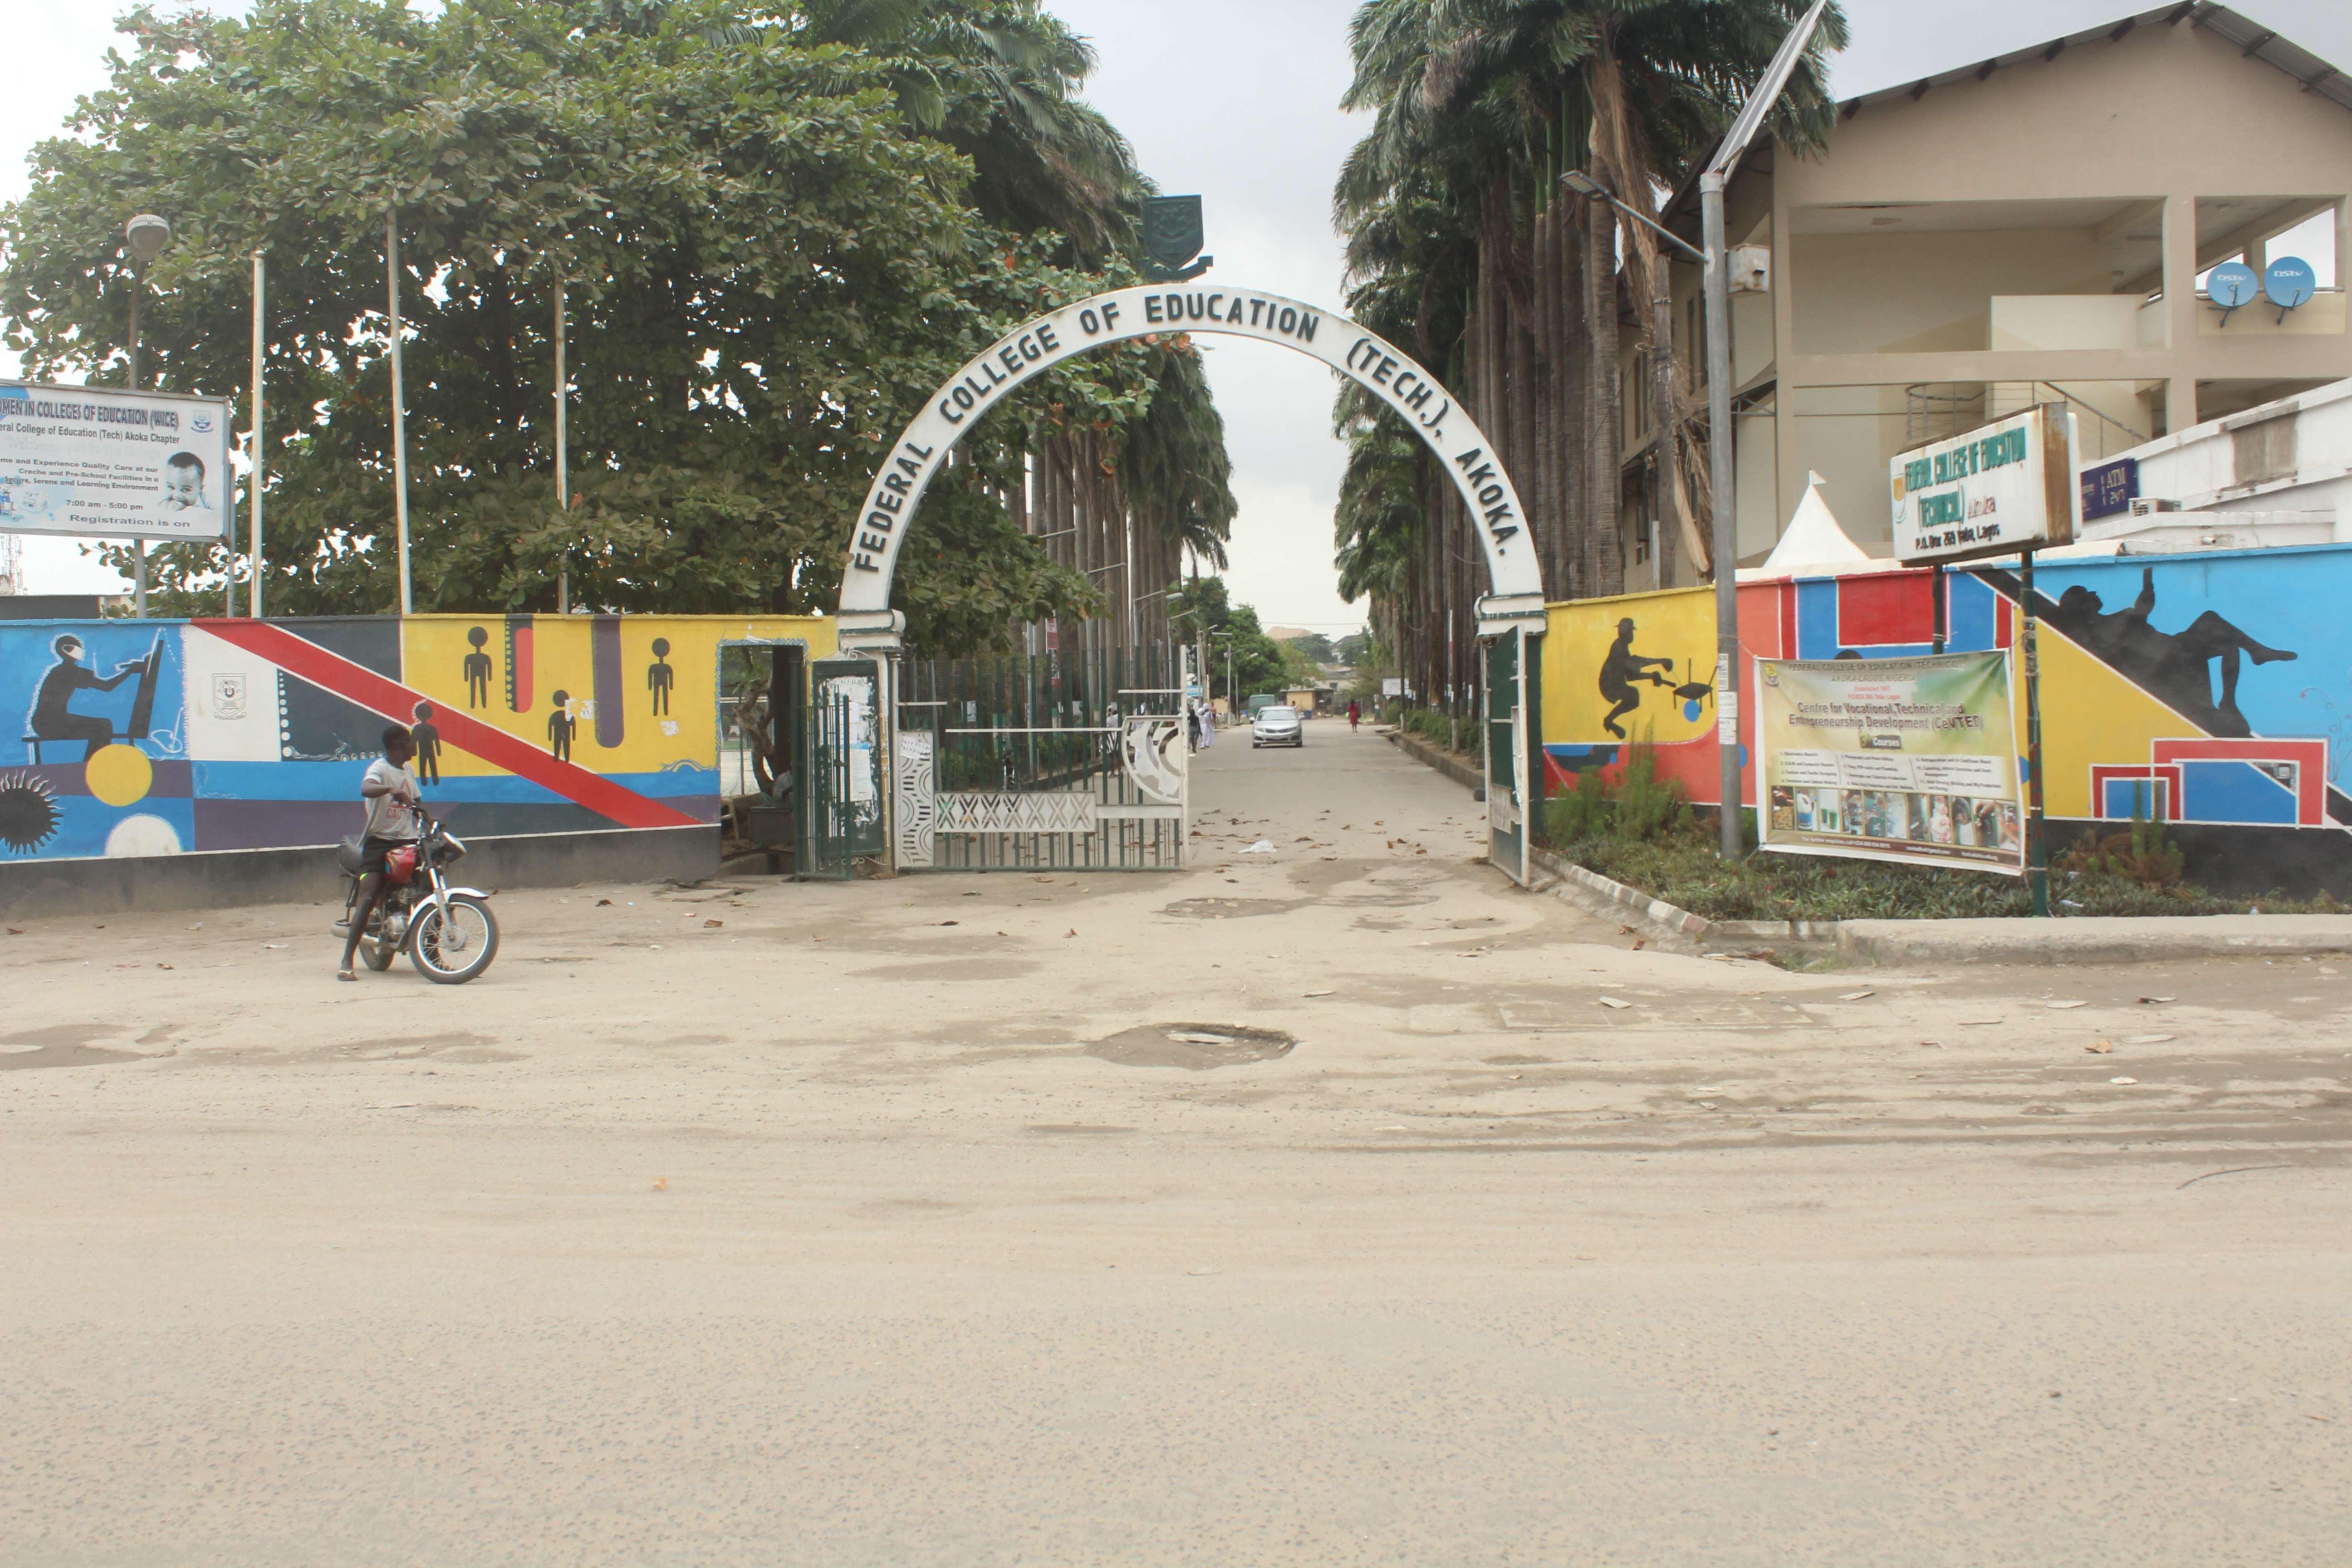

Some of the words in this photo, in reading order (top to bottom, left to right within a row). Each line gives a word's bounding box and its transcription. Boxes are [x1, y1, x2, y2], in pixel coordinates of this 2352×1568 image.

[0, 397, 23, 416] MEN
[24, 399, 35, 416] IN
[37, 401, 82, 420] COLLEGES
[84, 405, 96, 421] OF
[98, 406, 148, 426] EDUCATION
[150, 410, 179, 431] (WICE)
[16, 423, 46, 436] College
[48, 426, 56, 435] of
[59, 426, 97, 438] Education
[99, 429, 123, 441] (Tech)
[125, 431, 148, 442] Akoka
[150, 433, 181, 445] Chapter
[854, 441, 934, 573] FEDERAL
[938, 323, 1060, 425] COLLEGE
[1079, 302, 1121, 335] OF
[1145, 293, 1320, 343] EDUCATION
[1455, 447, 1519, 557] AKOKA.
[34, 459, 80, 468] Experience
[82, 462, 110, 471] Quality
[1935, 445, 1968, 485] COLLEGE
[5, 476, 32, 484] Secure,
[77, 480, 110, 489] Learning
[112, 482, 159, 491] Environment
[66, 471, 107, 479] Pre-School
[109, 473, 143, 481] Facilities
[2106, 467, 2127, 489] ATM
[70, 514, 154, 526] Registration
[1976, 523, 2000, 542] Lagos
[1798, 702, 1828, 714] Centre
[1830, 702, 1842, 714] for
[1946, 703, 1965, 715] and
[1789, 714, 1863, 728] Entrepreneurship
[1866, 715, 1929, 730] Development
[1872, 738, 1900, 747] Courses
